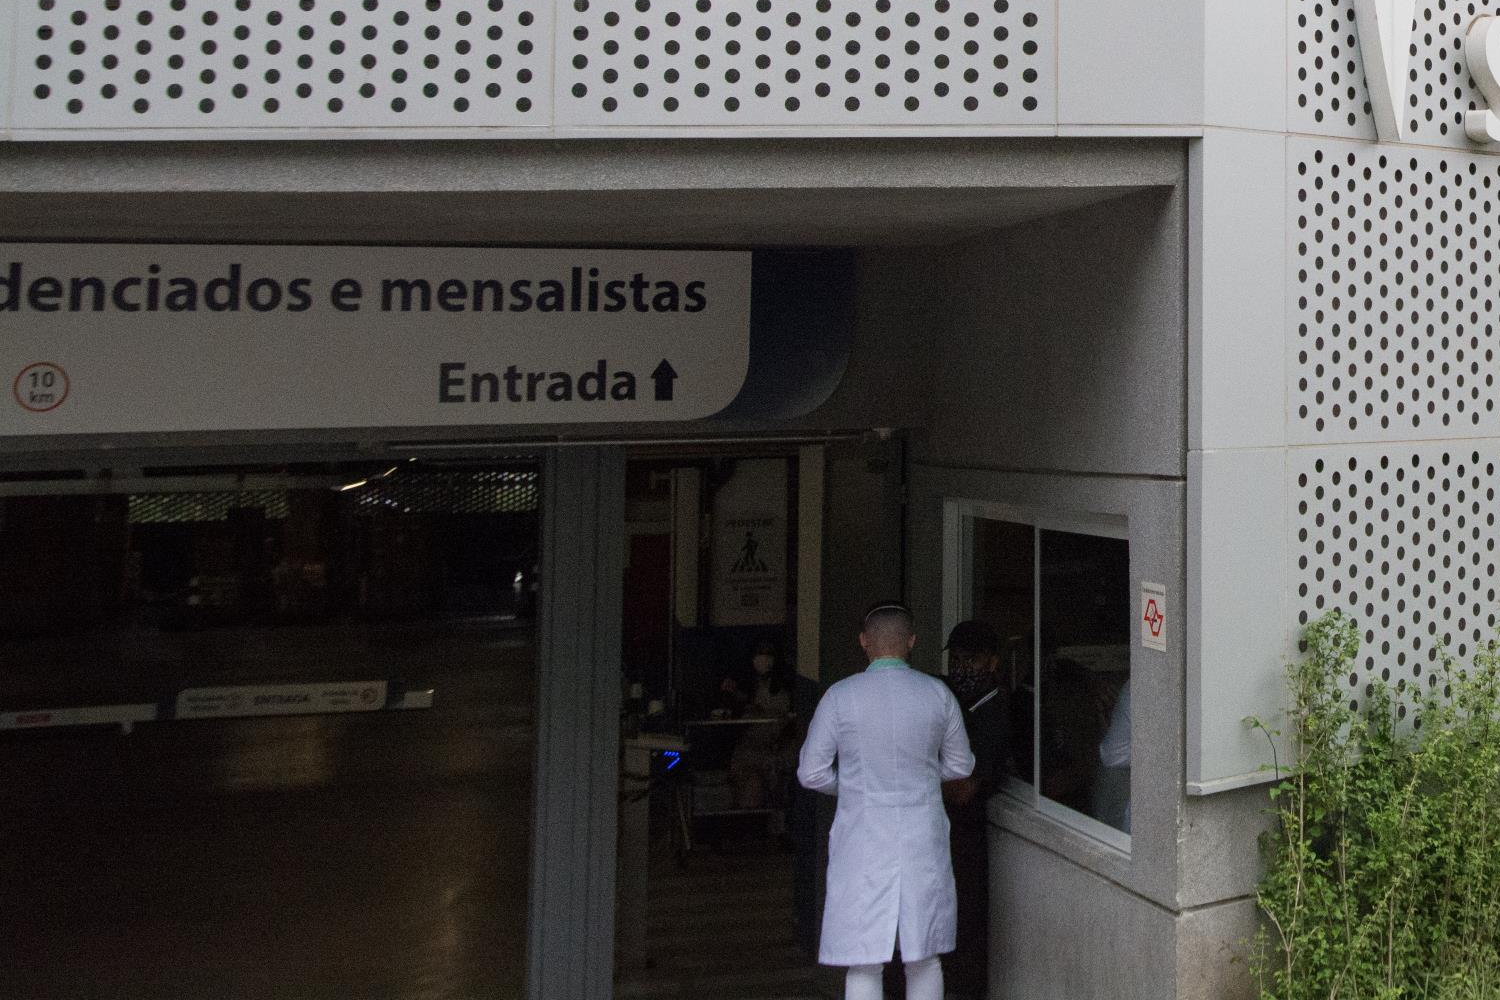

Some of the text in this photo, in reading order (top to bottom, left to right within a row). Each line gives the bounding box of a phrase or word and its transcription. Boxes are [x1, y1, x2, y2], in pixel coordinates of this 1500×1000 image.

[0, 263, 708, 314] denciados e mensalistas
[29, 371, 56, 389] 10
[438, 361, 638, 405] Entrada
[29, 390, 55, 404] km
